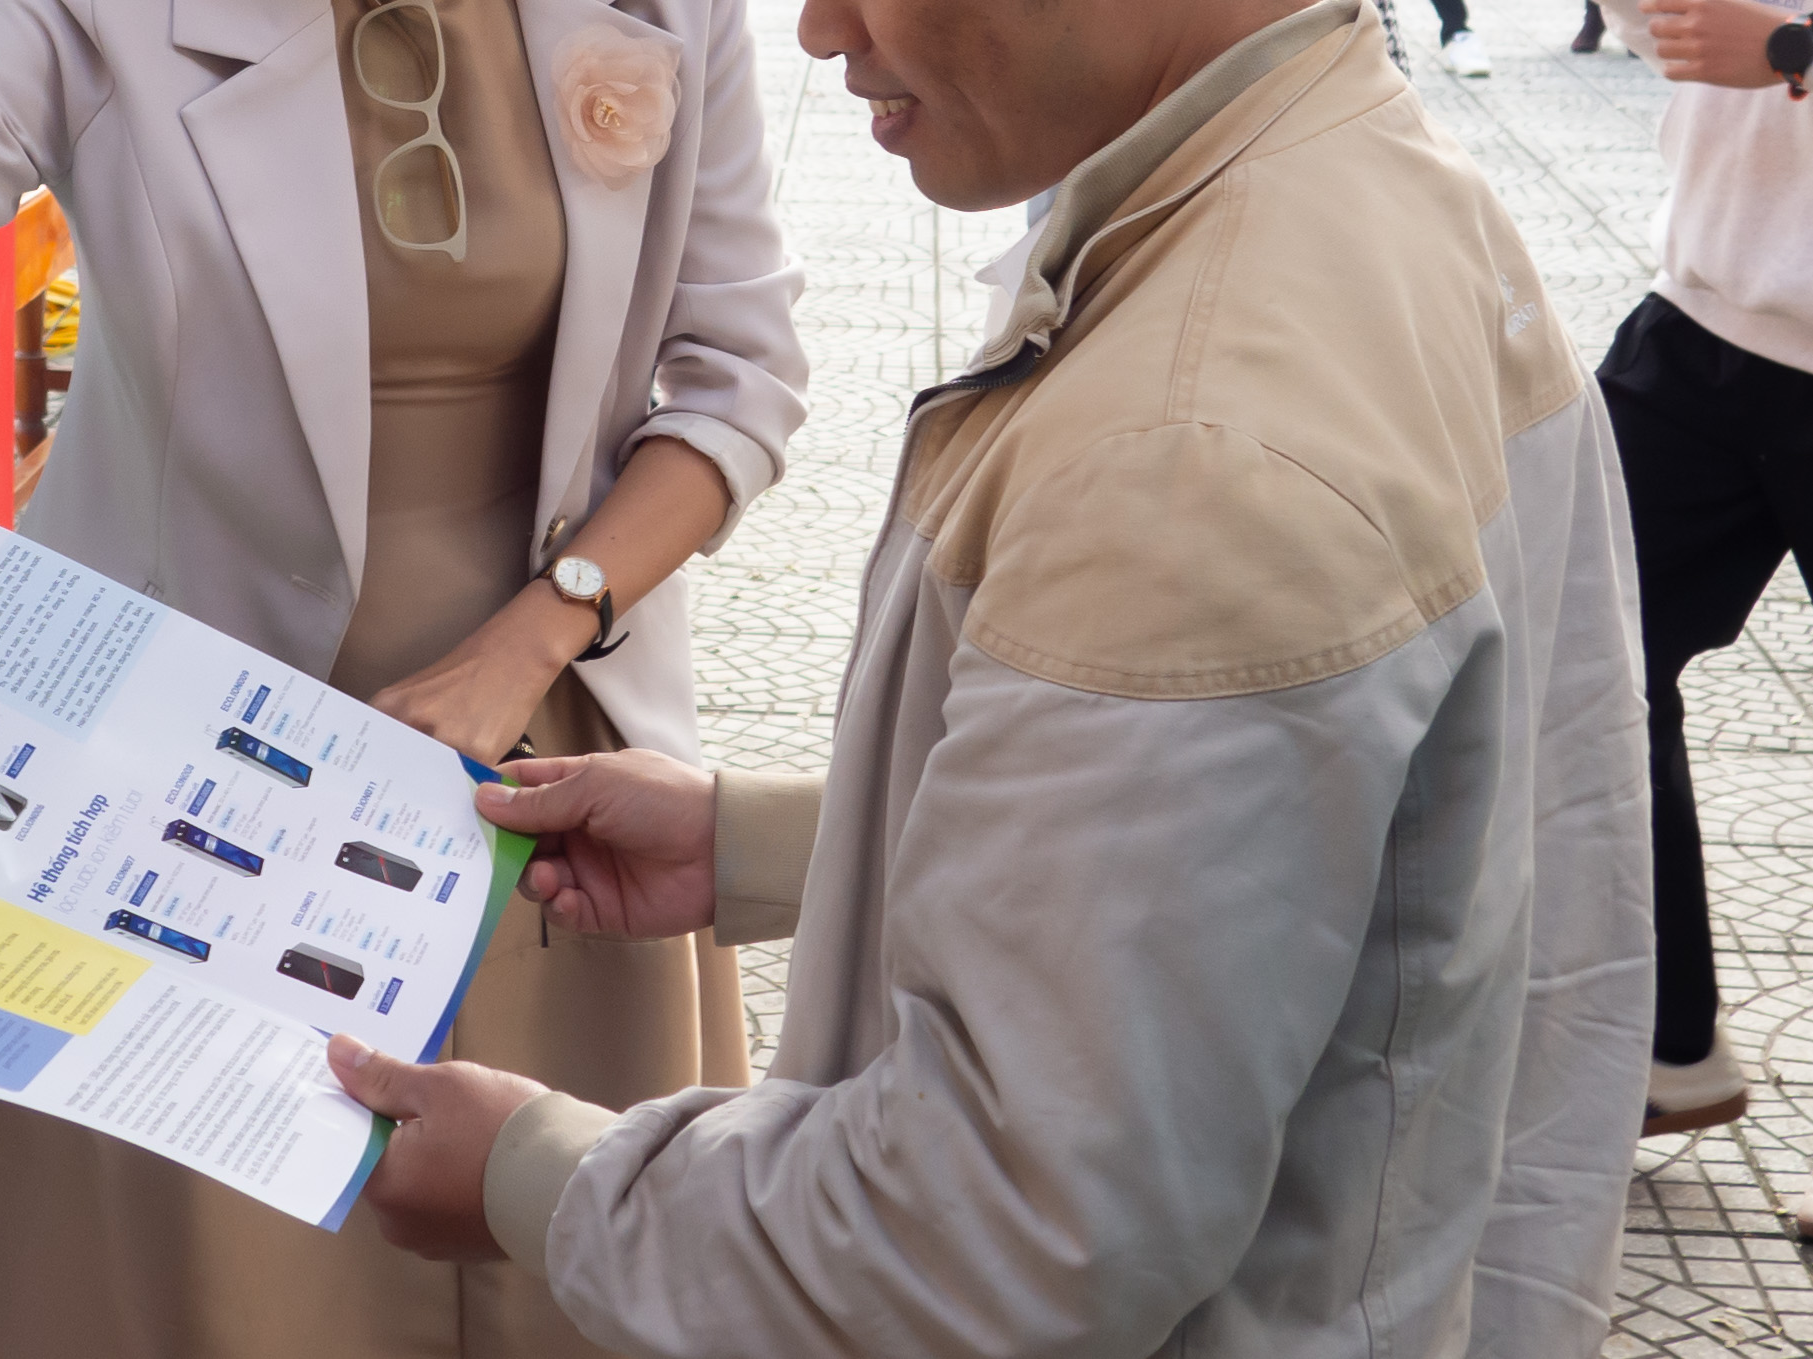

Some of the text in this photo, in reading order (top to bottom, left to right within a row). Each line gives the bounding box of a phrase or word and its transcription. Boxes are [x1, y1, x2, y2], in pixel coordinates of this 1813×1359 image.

[27, 794, 109, 903] Hệ thống tích hợp
